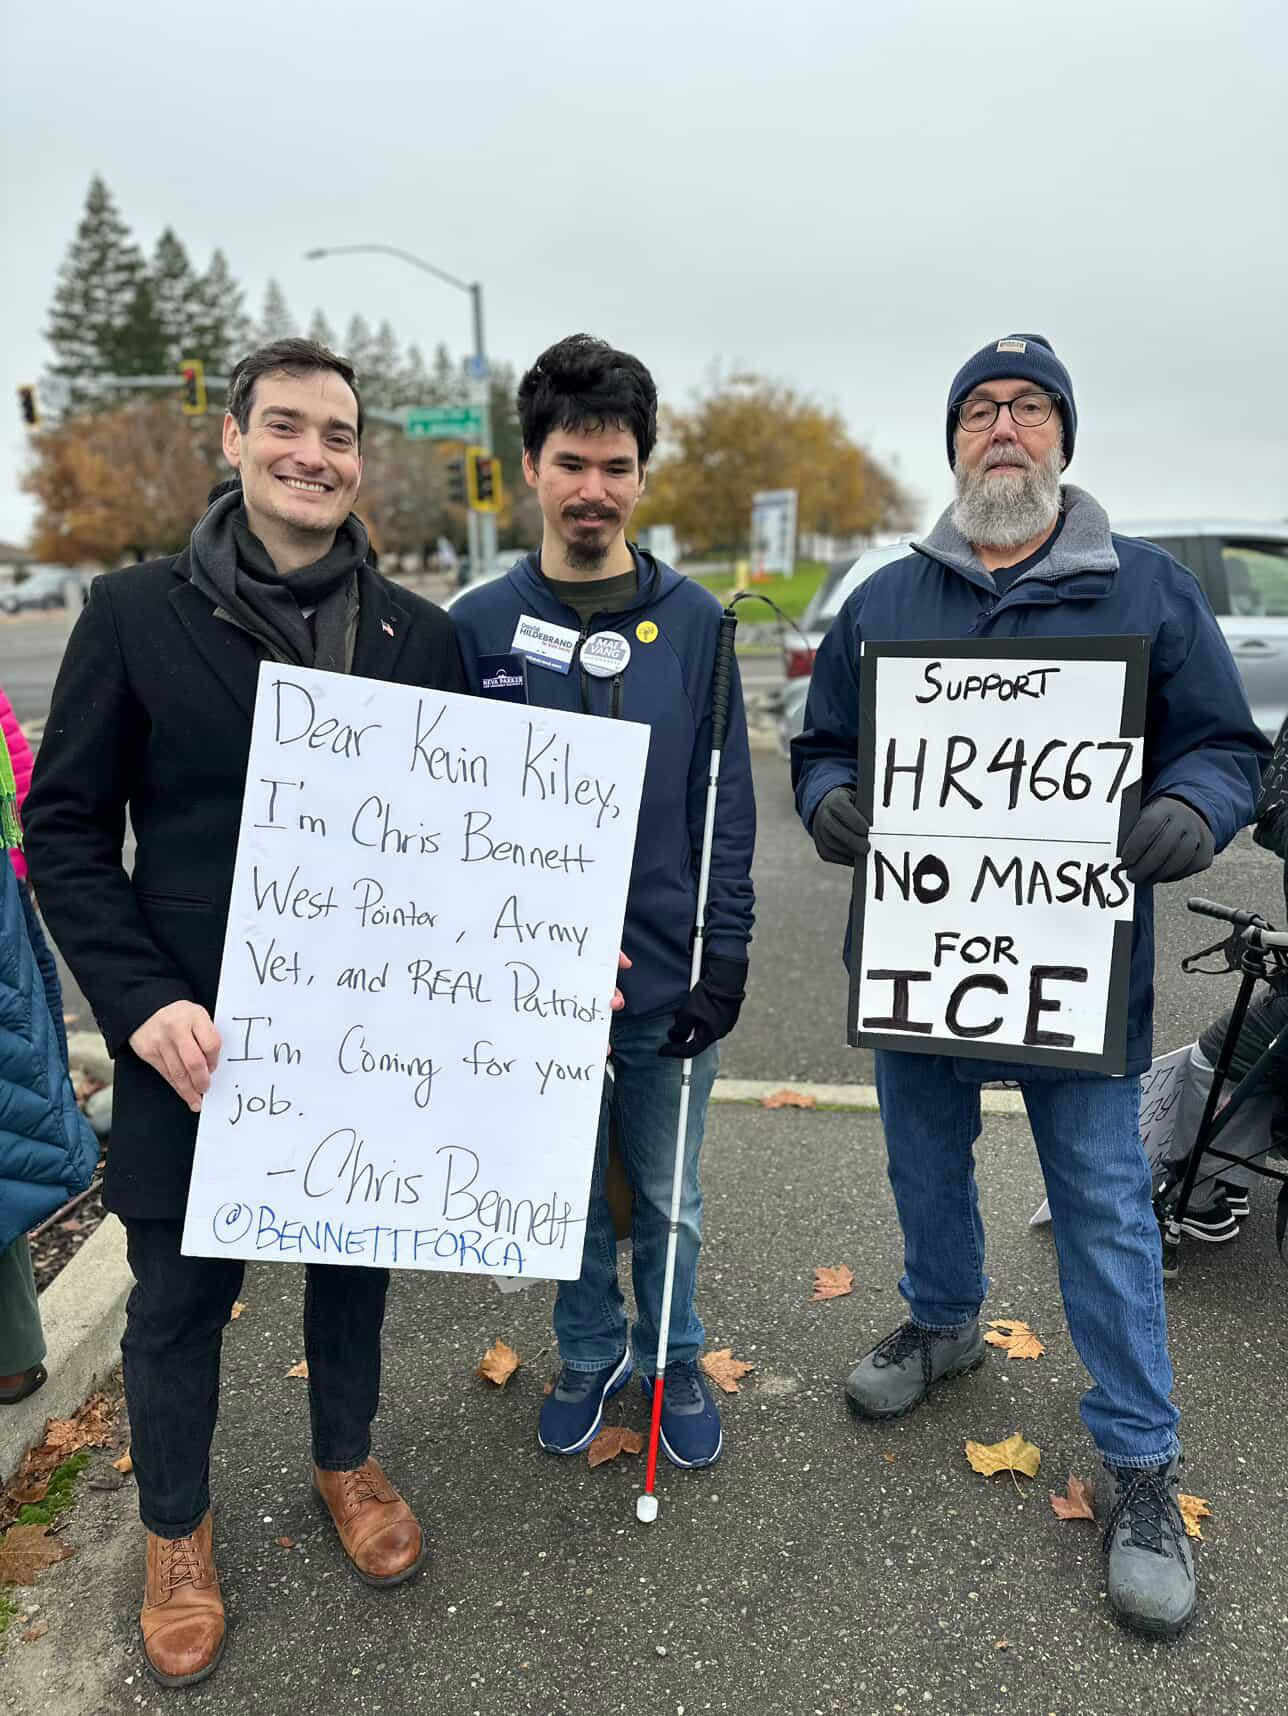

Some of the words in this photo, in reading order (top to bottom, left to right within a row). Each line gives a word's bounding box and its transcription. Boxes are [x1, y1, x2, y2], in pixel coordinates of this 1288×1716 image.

[519, 628, 573, 649] HILDEBRAND
[590, 646, 620, 658] VANG
[915, 662, 1060, 704] SUPPORT
[272, 680, 382, 757] Dear
[410, 699, 487, 787] Kevin
[522, 722, 619, 828] Kiley,
[882, 735, 1133, 811] HR4667
[254, 778, 326, 836] I'm
[352, 796, 440, 854] Chris
[461, 811, 595, 873] Bennett
[253, 866, 338, 919] West
[493, 896, 588, 956] Army
[874, 850, 950, 904] NO
[971, 855, 1130, 908] MASKS
[246, 939, 315, 986] Vet,
[337, 963, 388, 993] and
[407, 959, 492, 1005] REAL
[505, 962, 604, 1023] Patriot.
[934, 932, 1019, 967] FOR
[862, 965, 1088, 1047] ICE
[227, 1016, 301, 1065] I'm
[339, 1025, 441, 1108] Coming
[463, 1040, 516, 1077] for
[536, 1062, 595, 1094] your
[229, 1085, 304, 1125] job.
[436, 1145, 585, 1249] Bennett
[212, 1202, 526, 1273] @BENNETTFORCA
